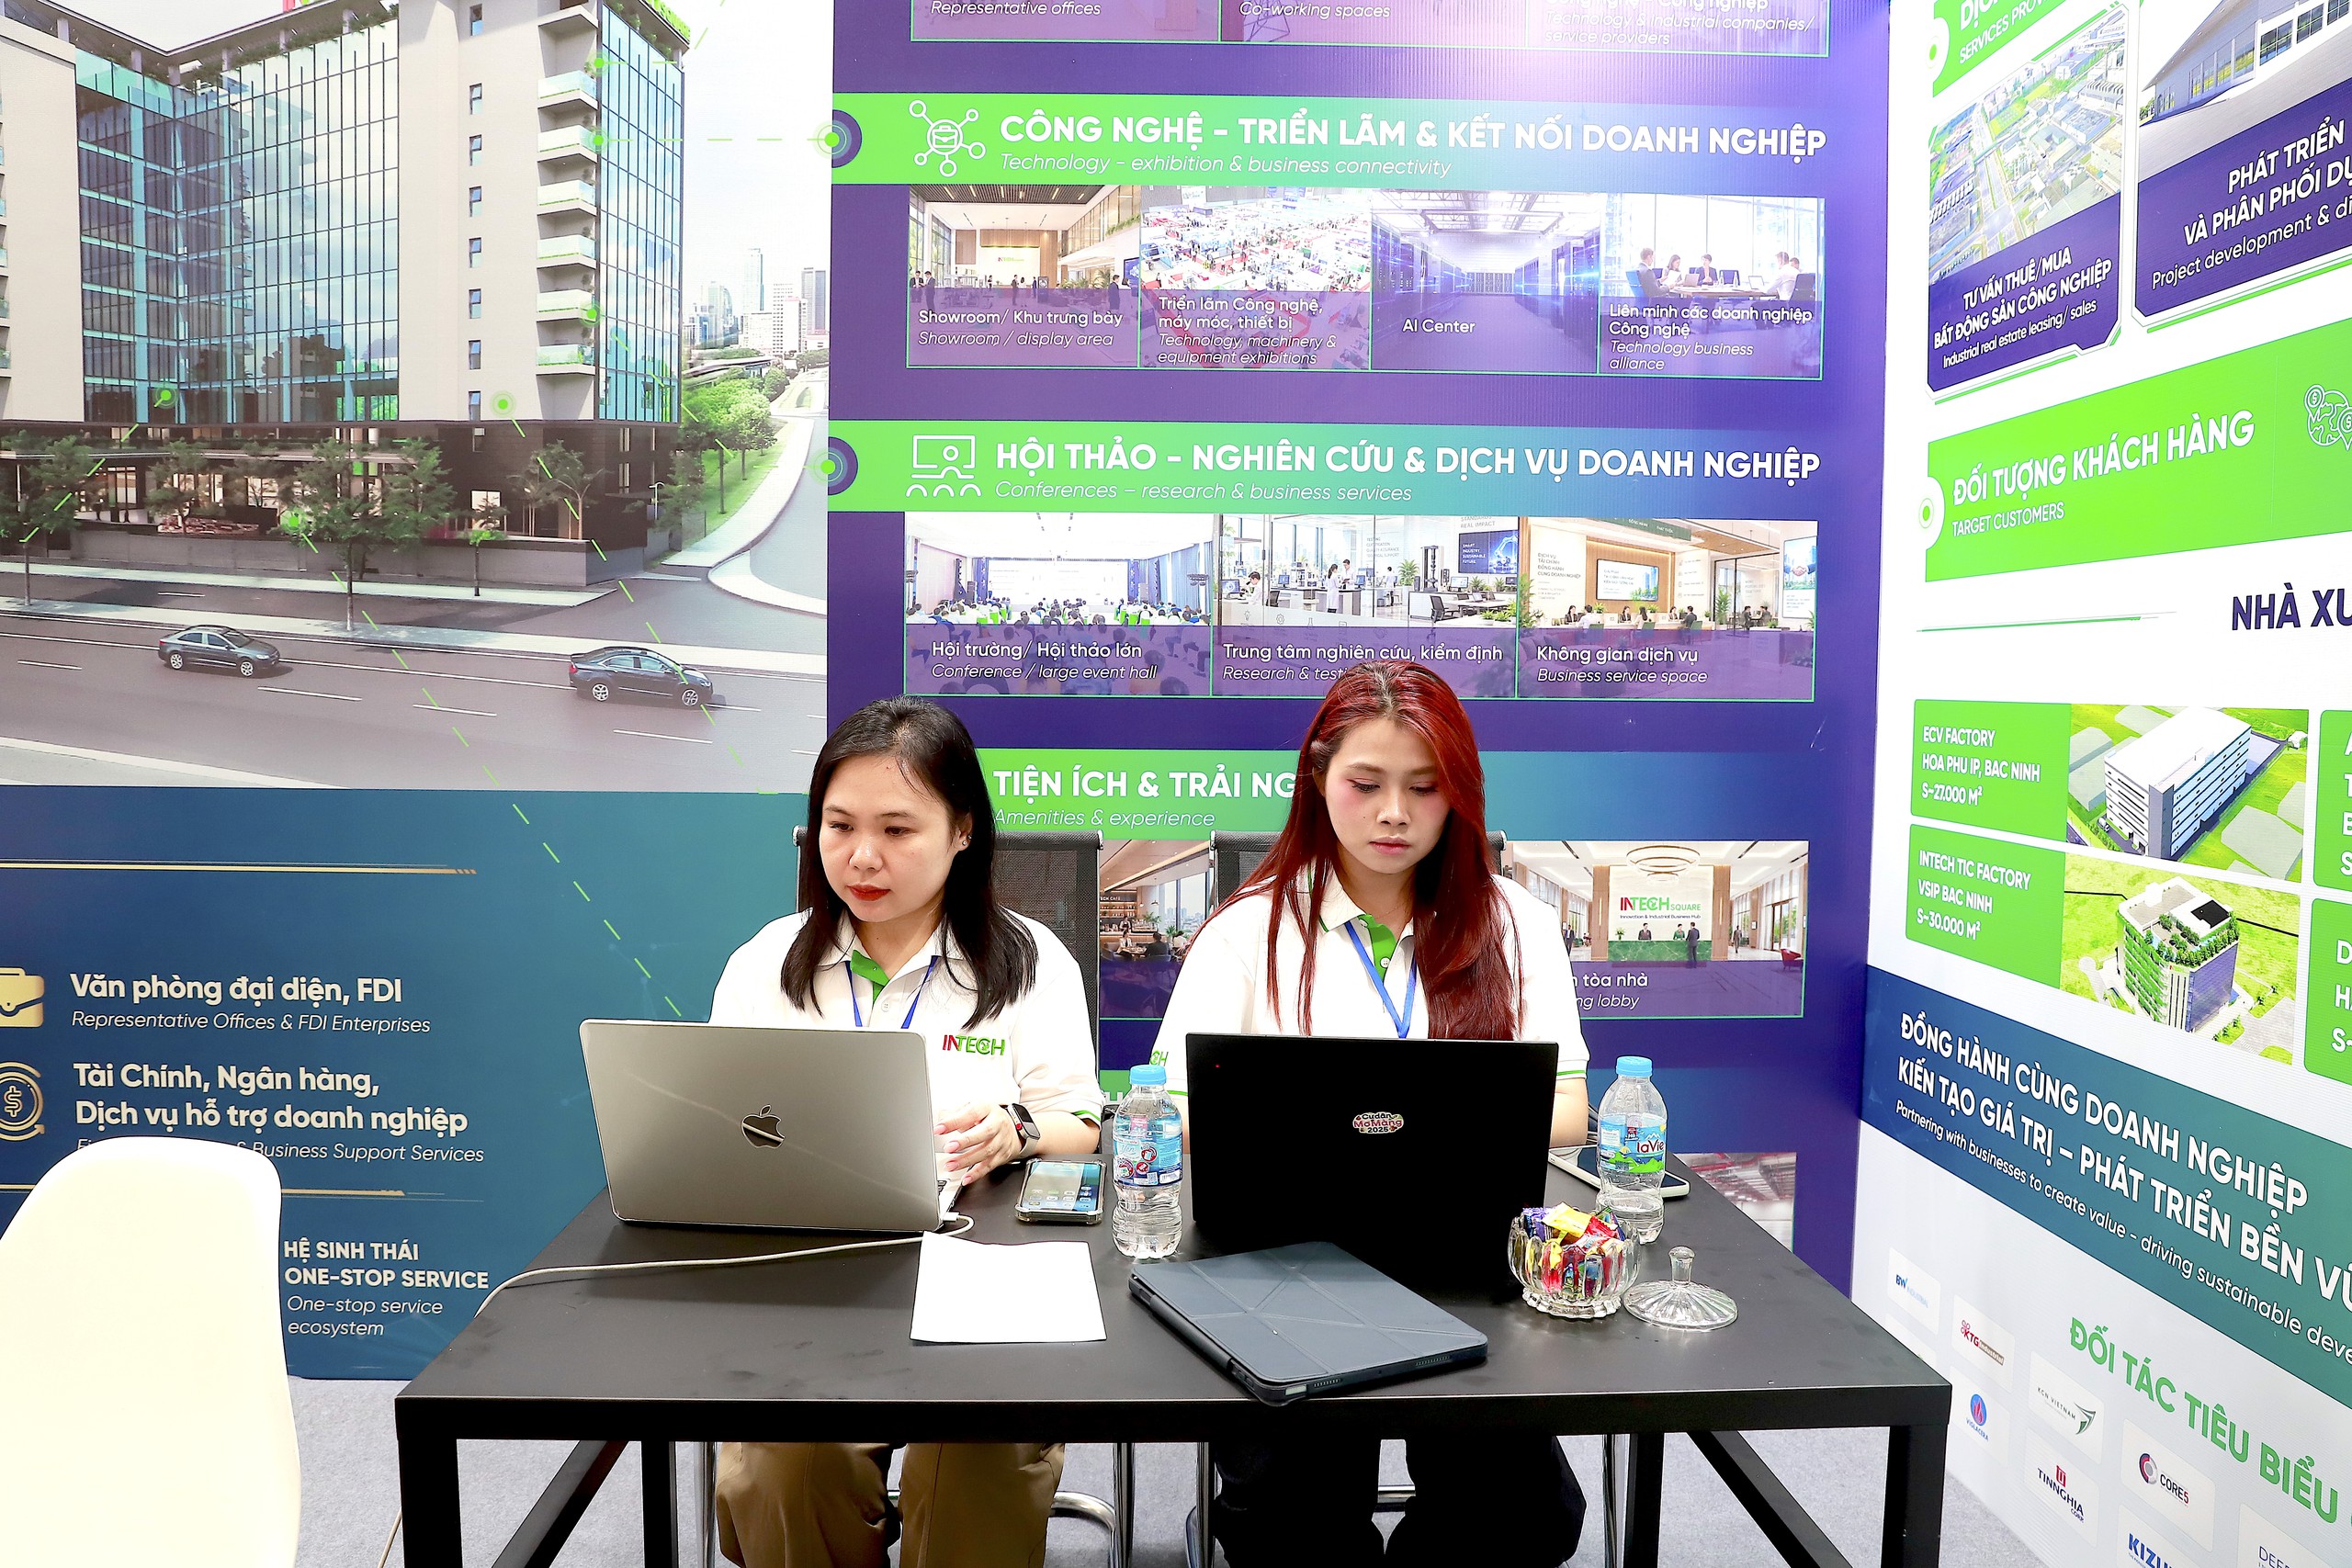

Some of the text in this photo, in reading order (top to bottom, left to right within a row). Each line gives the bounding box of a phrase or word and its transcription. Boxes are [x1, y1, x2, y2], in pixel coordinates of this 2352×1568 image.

[931, 1, 1101, 16] Representative offices
[1240, 1, 1390, 19] Co-working spaces
[1001, 109, 1102, 142] CÔNG
[1113, 111, 1204, 152] NGHỆ
[1238, 107, 1328, 145] TRIỂN
[1339, 112, 1406, 147] LÃM
[1416, 122, 1438, 147] &
[1449, 113, 1506, 147] KẾT
[1515, 114, 1572, 151] NỐI
[1582, 125, 1698, 153] DOANH
[1710, 123, 1826, 164] NGHIỆP
[2228, 116, 2346, 194] PHÁT TRIỂN
[1963, 246, 2072, 310] TƯ VẤN THUÊ/MUA
[1934, 257, 2113, 349] BẤT ĐỘNG SẢN CÔNG NGHIỆP
[918, 310, 1123, 329] Showroom/ Khu trưng bày
[1402, 319, 1476, 333] AI Center
[918, 332, 1000, 346] Showroom
[1017, 332, 1073, 348] display
[1076, 334, 1114, 346] area
[1943, 299, 2097, 368] Industrial real estate leasing/ sales
[1611, 340, 1754, 356] Technology business
[1610, 356, 1665, 370] alliance
[1953, 411, 2255, 505] ĐỐI TƯỢNG KHÁCH HÀNG
[1952, 502, 2064, 536] TARGET CUSTOMERS
[2233, 582, 2300, 630] NHÀ
[932, 640, 1142, 660] Hội trường/ Hội thảo lớn
[1537, 645, 1698, 666] Không gian dịch vụ
[932, 664, 1022, 679] Conference
[1038, 664, 1078, 682] large
[1082, 667, 1125, 680] event
[1128, 665, 1158, 679] hall
[1537, 669, 1707, 686] Business service space
[1923, 726, 1995, 747] ECV FACTORY
[1923, 754, 2041, 782] HOA PHU IP, BAC NINH
[993, 764, 1061, 805] TIỆN
[1072, 764, 1127, 797] ÍCH
[1138, 772, 1160, 797] &
[1169, 764, 1239, 797] TRẢI
[995, 809, 1216, 829] Amenities & experience
[1919, 851, 2031, 890] INTECH TIC FACTORY
[1621, 897, 1669, 910] INTECH
[1918, 879, 1993, 913] VSIP BAC NINH
[71, 974, 402, 1008] Văn phòng đại diện, FDI
[1583, 973, 1611, 987] tòa
[1616, 973, 1648, 987] nhà
[1597, 993, 1640, 1010] lobby
[72, 1010, 430, 1034] Representative Offices & FDI Enterprises
[943, 1034, 1005, 1055] INTECH
[74, 1063, 379, 1098] Tài Chính, Ngân hàng,
[75, 1098, 469, 1138] Dịch vụ hỗ trợ doanh nghiệp
[1901, 1011, 2308, 1220] ĐỒNG HÀNH CÙNG DOANH NGHIỆP
[1637, 1139, 1664, 1153] laVie
[284, 1236, 419, 1263] HỆ SINH THÁI
[285, 1267, 489, 1289] ONE-STOP SERVICE
[288, 1295, 443, 1315] One-stop service
[288, 1320, 384, 1337] ecosystem
[1964, 1329, 2004, 1365] KTG Industrial
[2038, 1387, 2075, 1420] KCN VIETNAM
[1966, 1418, 1988, 1440] VIGLACERA
[2070, 1317, 2338, 1524] ĐỐI TÁC TIÊU BIỂU
[2038, 1468, 2084, 1516] TINNGHIA
[2160, 1473, 2188, 1505] CORE5
